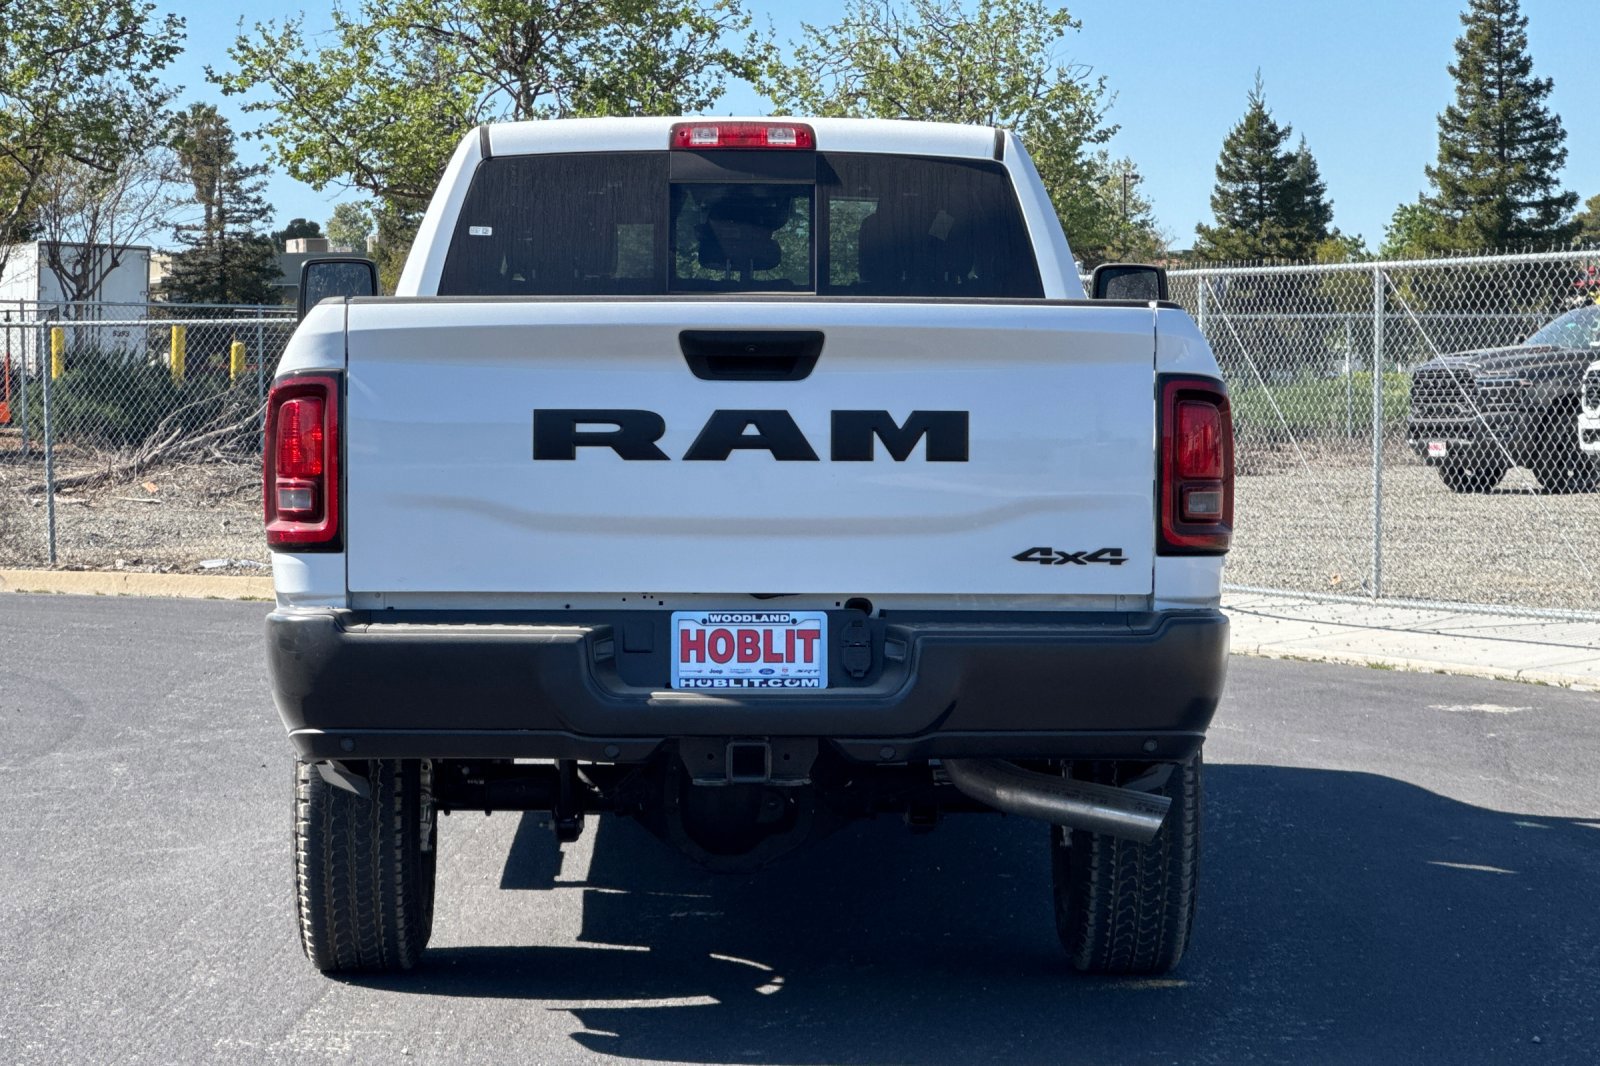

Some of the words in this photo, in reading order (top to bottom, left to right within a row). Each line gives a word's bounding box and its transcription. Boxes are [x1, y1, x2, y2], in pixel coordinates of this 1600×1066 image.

[533, 409, 969, 461] RAM
[1011, 547, 1129, 565] 4x4
[709, 615, 789, 623] WOODLAND
[681, 628, 820, 664] HOBLIT
[680, 679, 819, 687] HOBLIT.COM
